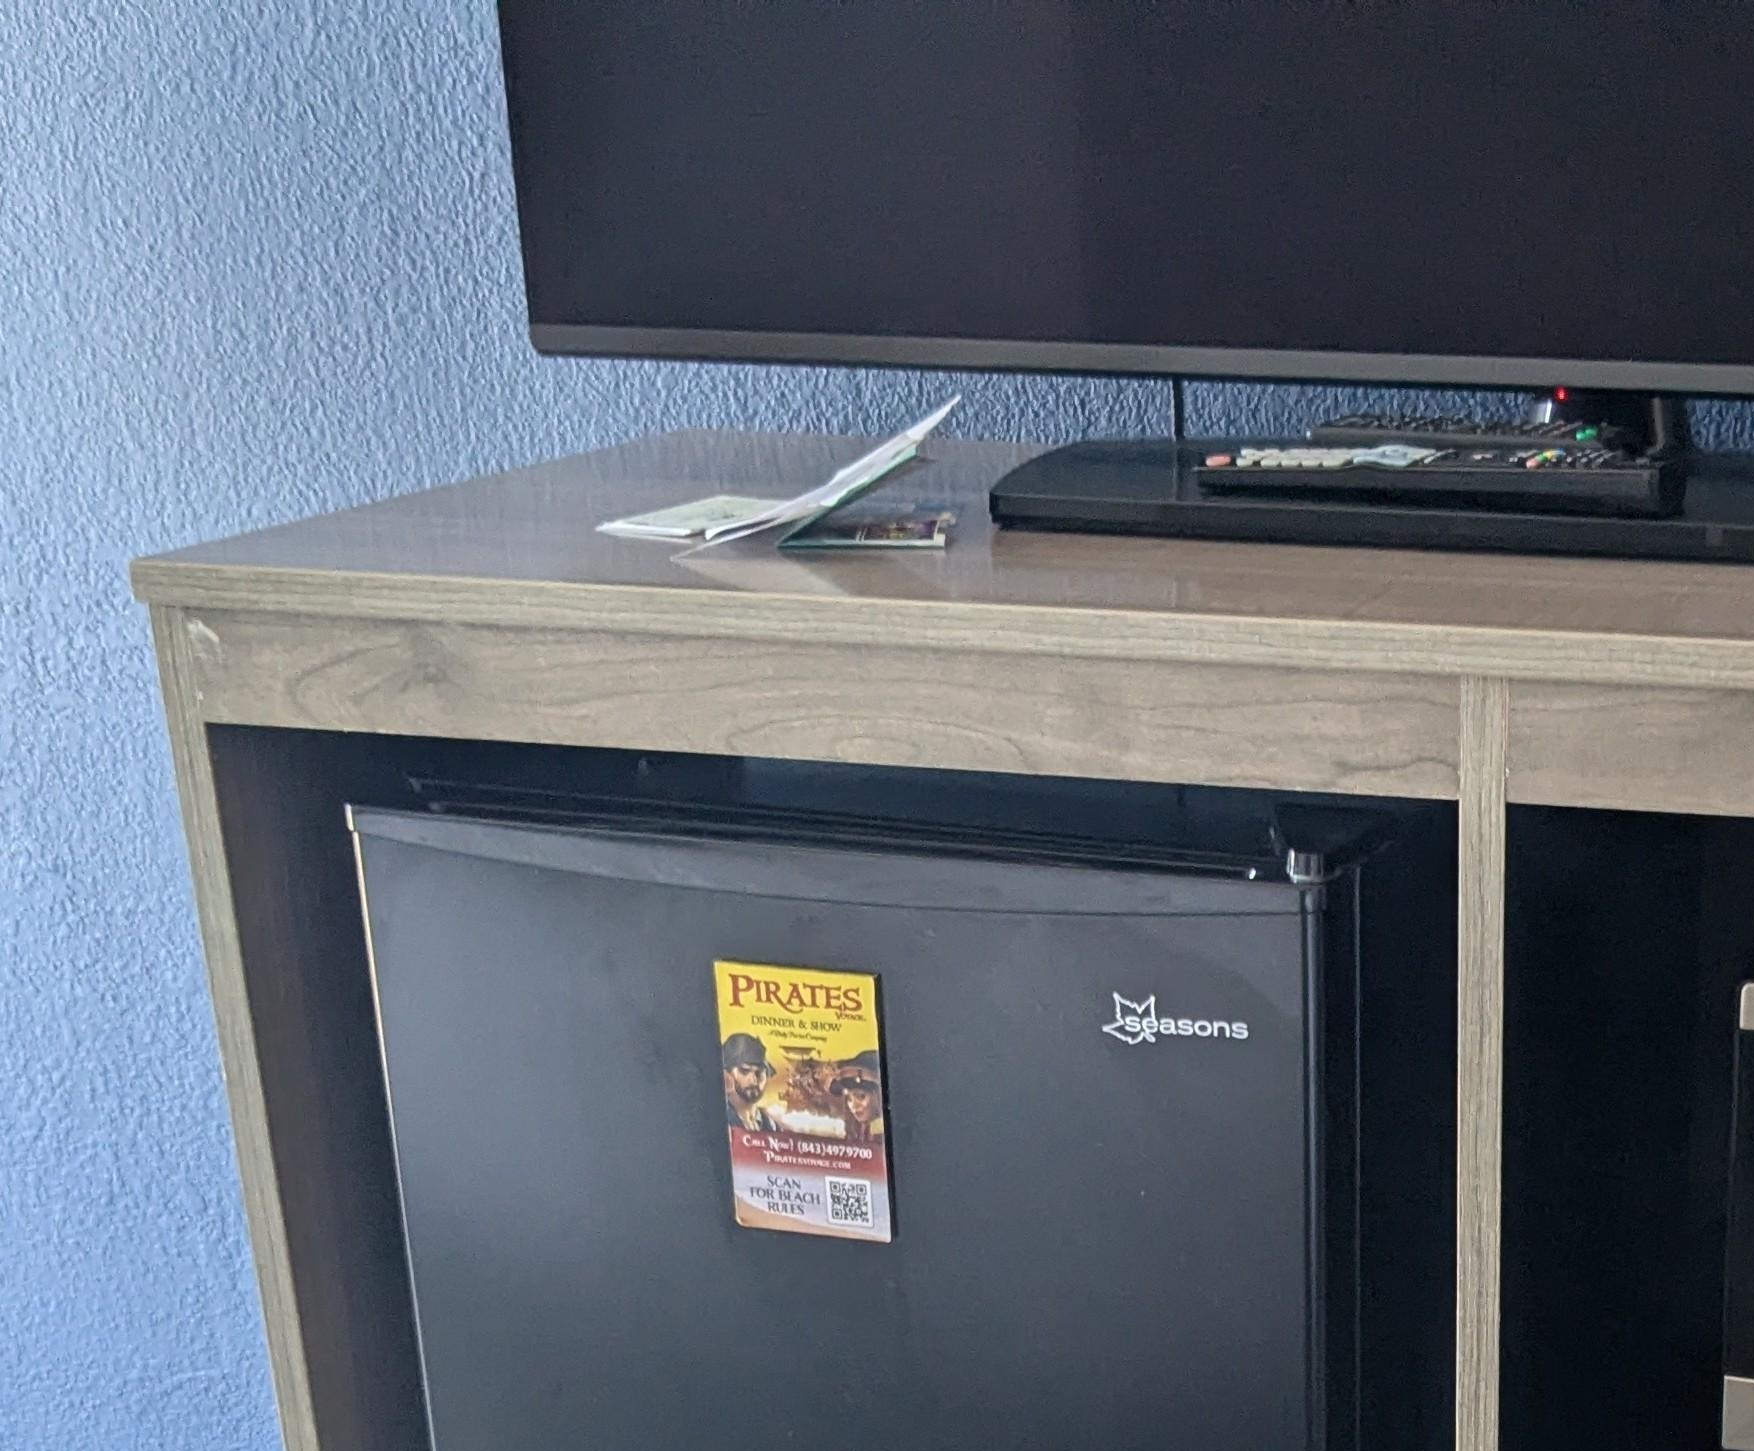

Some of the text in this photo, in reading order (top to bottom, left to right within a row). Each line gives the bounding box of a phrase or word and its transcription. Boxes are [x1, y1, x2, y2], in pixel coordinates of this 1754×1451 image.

[728, 973, 863, 1014] PIRATES
[751, 1015, 842, 1032] DINNER & SHOW
[1124, 1015, 1249, 1039] seasons
[767, 1175, 801, 1189] SCAN
[750, 1187, 821, 1205] FOR BEACH
[767, 1201, 805, 1215] RULES
